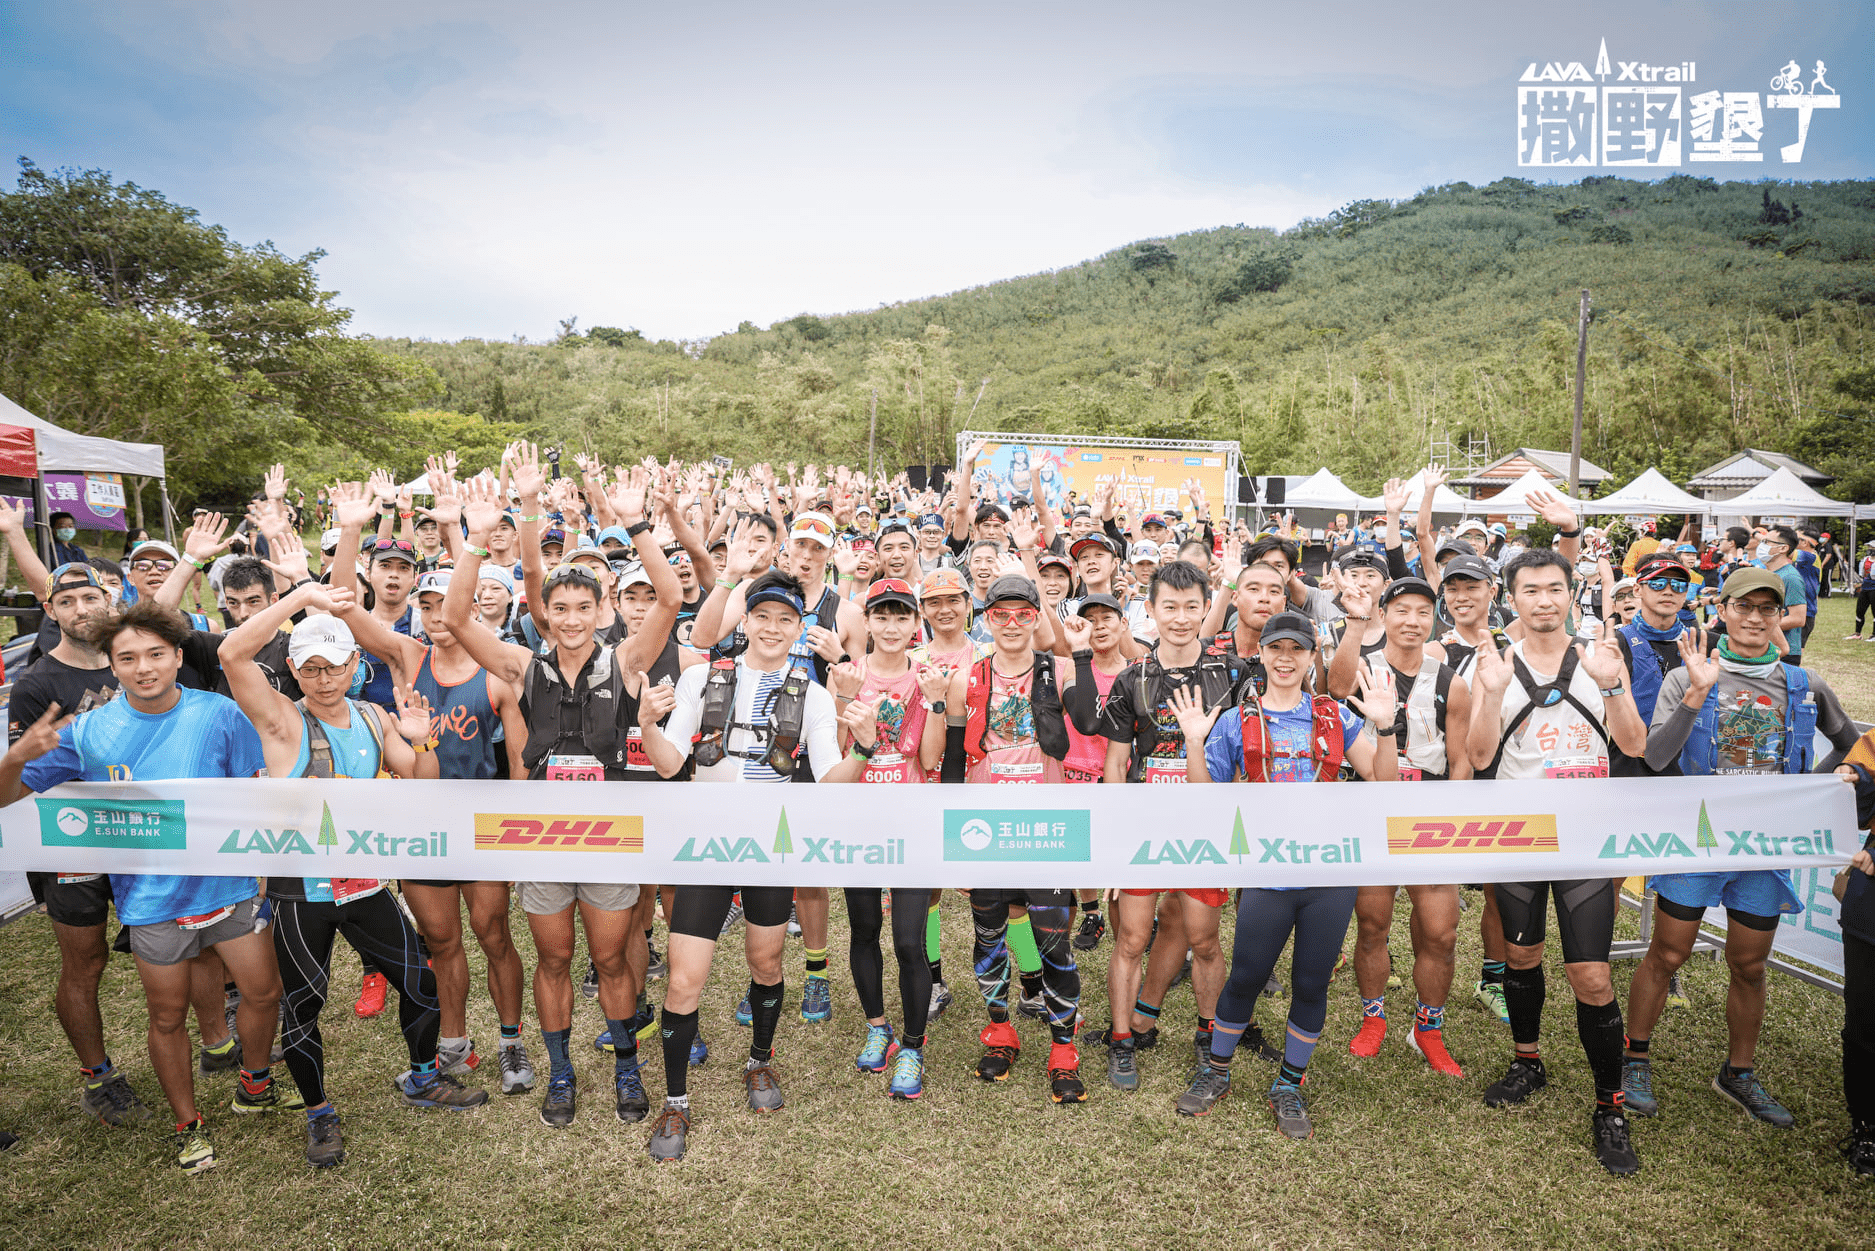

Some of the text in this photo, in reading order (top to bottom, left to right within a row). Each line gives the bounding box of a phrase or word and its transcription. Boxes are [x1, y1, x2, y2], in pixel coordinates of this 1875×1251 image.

[1536, 722, 1593, 752] 台灣
[865, 769, 902, 783] 6006
[94, 810, 161, 825] 玉山銀行
[998, 822, 1067, 837] 玉山銀行
[95, 827, 161, 837] E.SUN BANK
[217, 829, 448, 857] LAVA Xtrail
[498, 819, 621, 846] DHL
[999, 840, 1066, 849] E.SUN BANK
[1408, 821, 1535, 848] DHL
[1597, 829, 1836, 859] LAVA Xtrail
[673, 837, 905, 865] LAVA Xtrail
[1129, 838, 1362, 865] LAVA Xtrail
